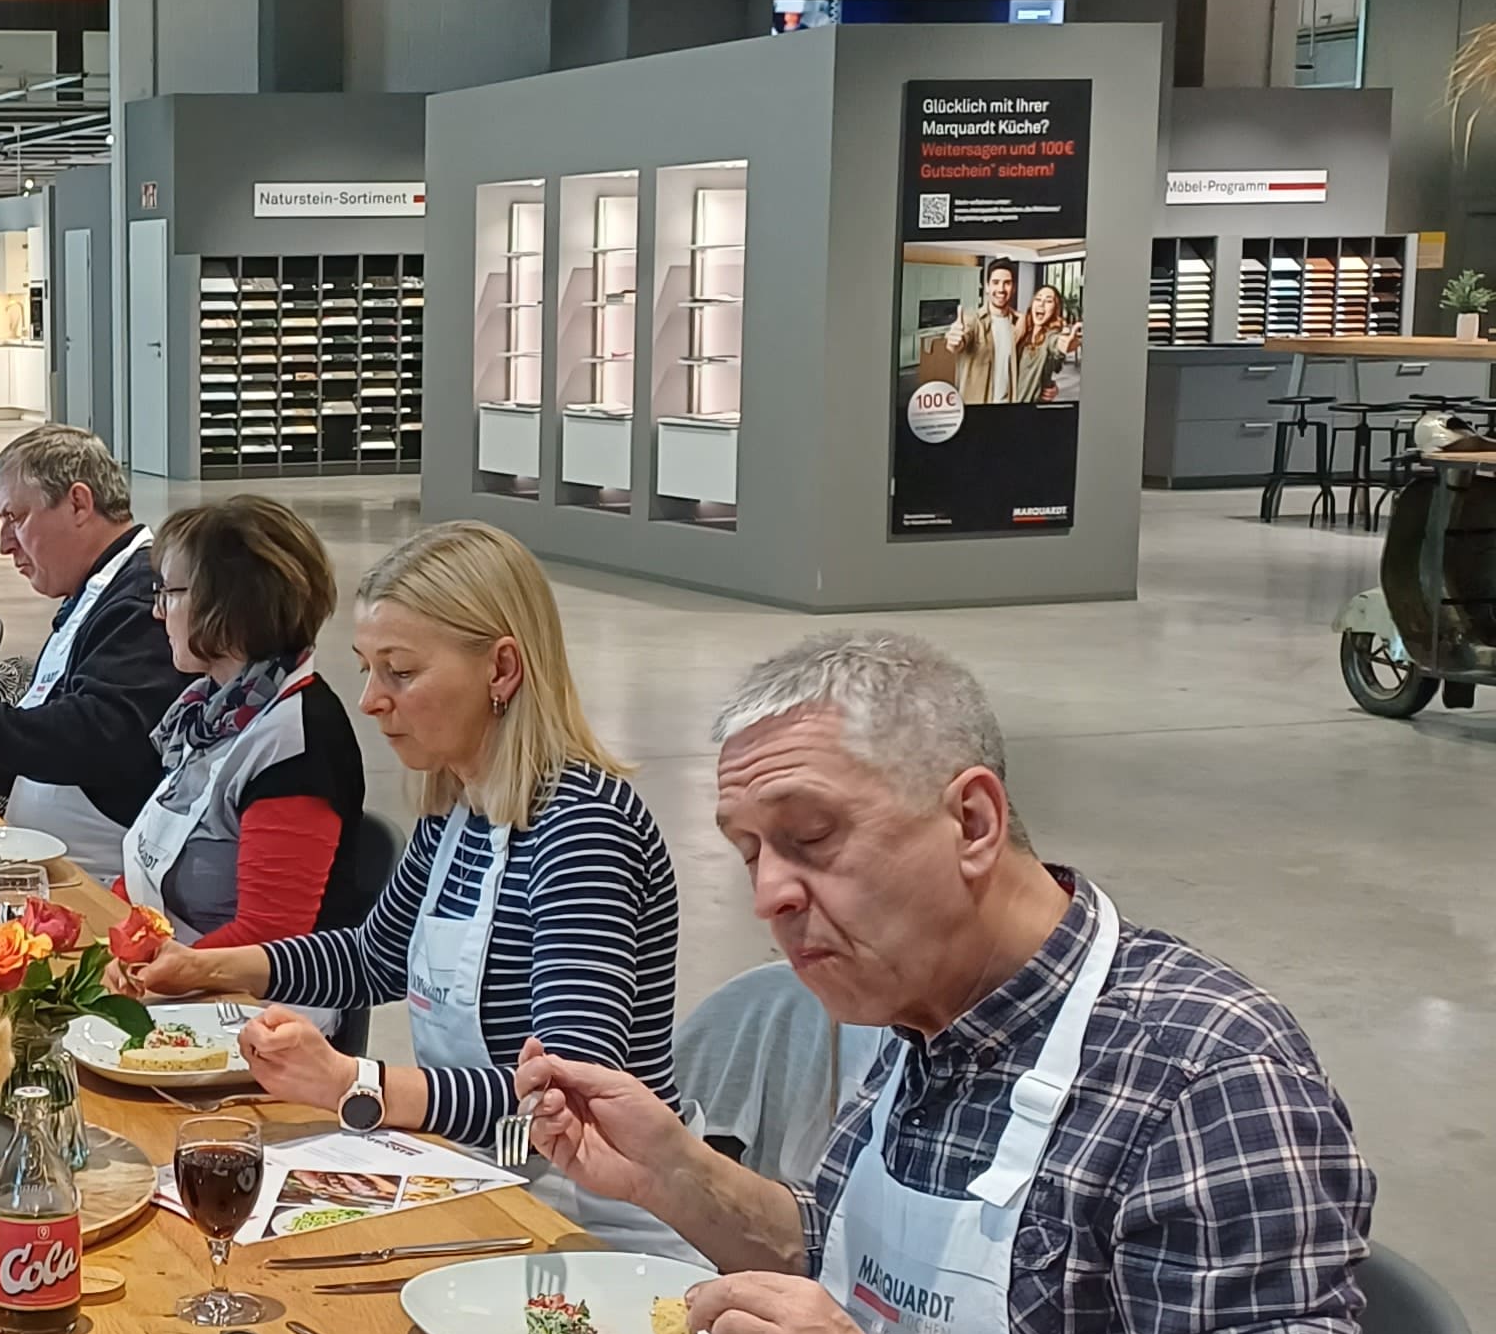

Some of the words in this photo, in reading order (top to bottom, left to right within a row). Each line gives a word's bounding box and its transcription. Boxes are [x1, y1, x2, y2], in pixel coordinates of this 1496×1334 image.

[922, 98, 987, 114] Glücklich
[990, 98, 1013, 113] mit
[1015, 98, 1050, 113] Ihrer
[922, 120, 995, 139] Marquardt
[998, 119, 1050, 135] Küche?
[921, 142, 1007, 159] Weitersagen
[1009, 141, 1036, 156] und
[998, 162, 1055, 177] sichern!
[1167, 179, 1267, 196] Möbel-Programm
[259, 190, 408, 205] Naturstein-Sortiment
[916, 392, 943, 409] 100
[1012, 505, 1068, 517] MARQUARDT
[0, 1240, 79, 1295] Cola
